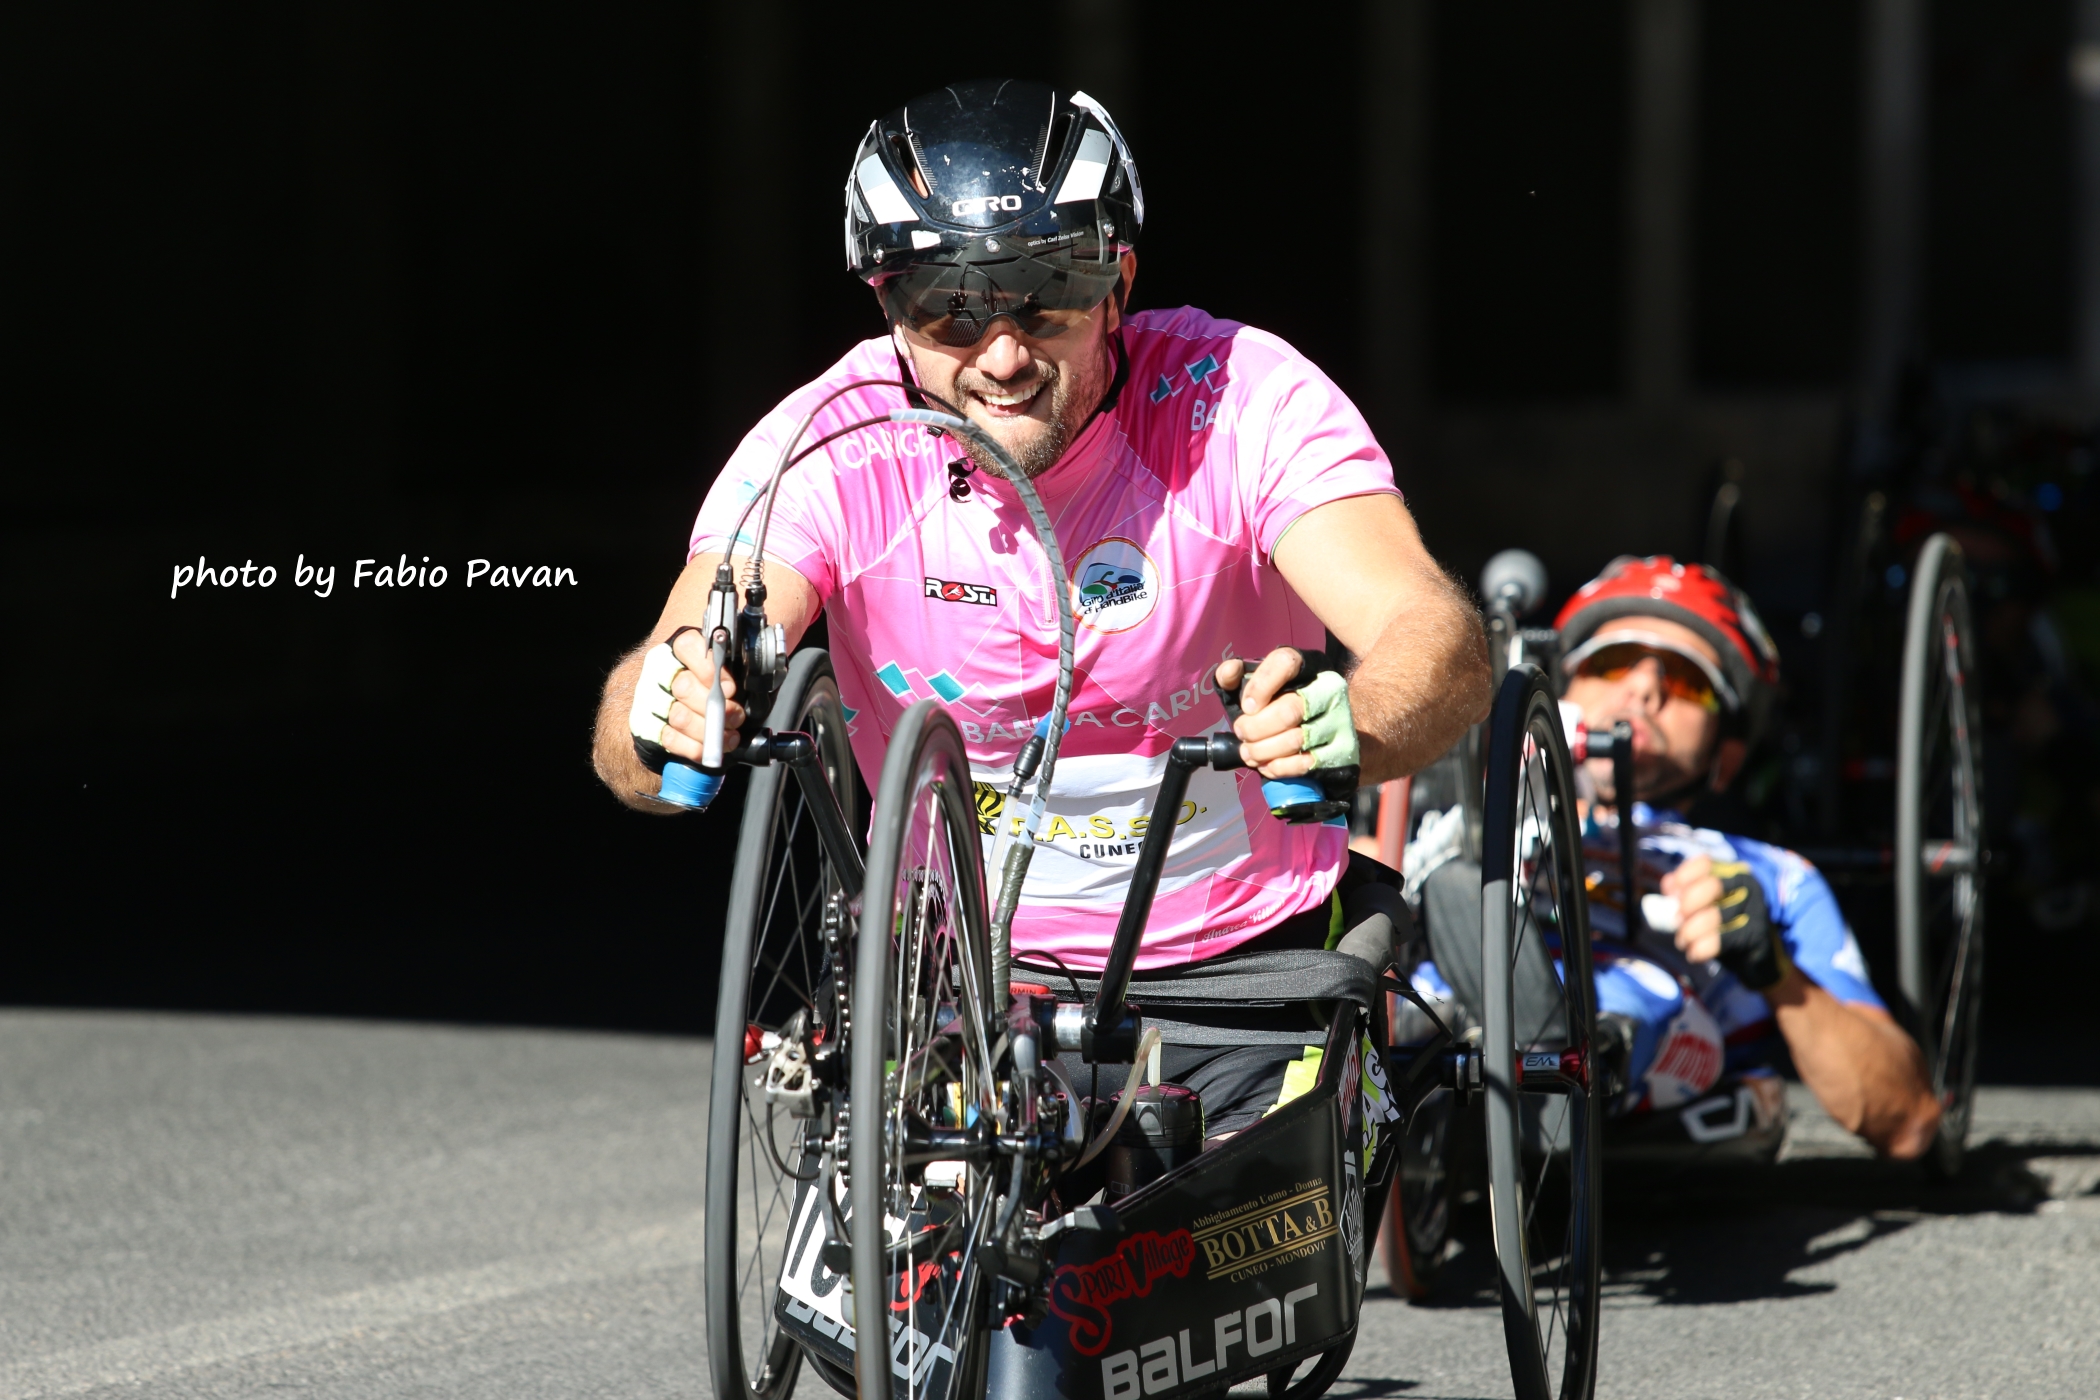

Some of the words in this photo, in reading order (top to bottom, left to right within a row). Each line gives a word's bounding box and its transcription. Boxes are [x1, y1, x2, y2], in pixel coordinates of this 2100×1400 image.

[1027, 238, 1040, 247] optics
[1041, 237, 1047, 245] by
[1047, 235, 1058, 243] Carl
[1058, 234, 1070, 242] Zeiss
[1070, 231, 1085, 240] Vision
[1082, 594, 1105, 607] Giro
[960, 711, 1105, 743] BANA
[1079, 841, 1143, 859] CUNE
[1192, 1198, 1259, 1230] Abbigliamento
[1259, 1189, 1288, 1205] Uomo
[1295, 1177, 1323, 1193] Donna
[1200, 1211, 1304, 1269] BOTTA
[1305, 1215, 1318, 1233] &
[1312, 1197, 1334, 1229] B
[1230, 1261, 1268, 1283] CUNEO
